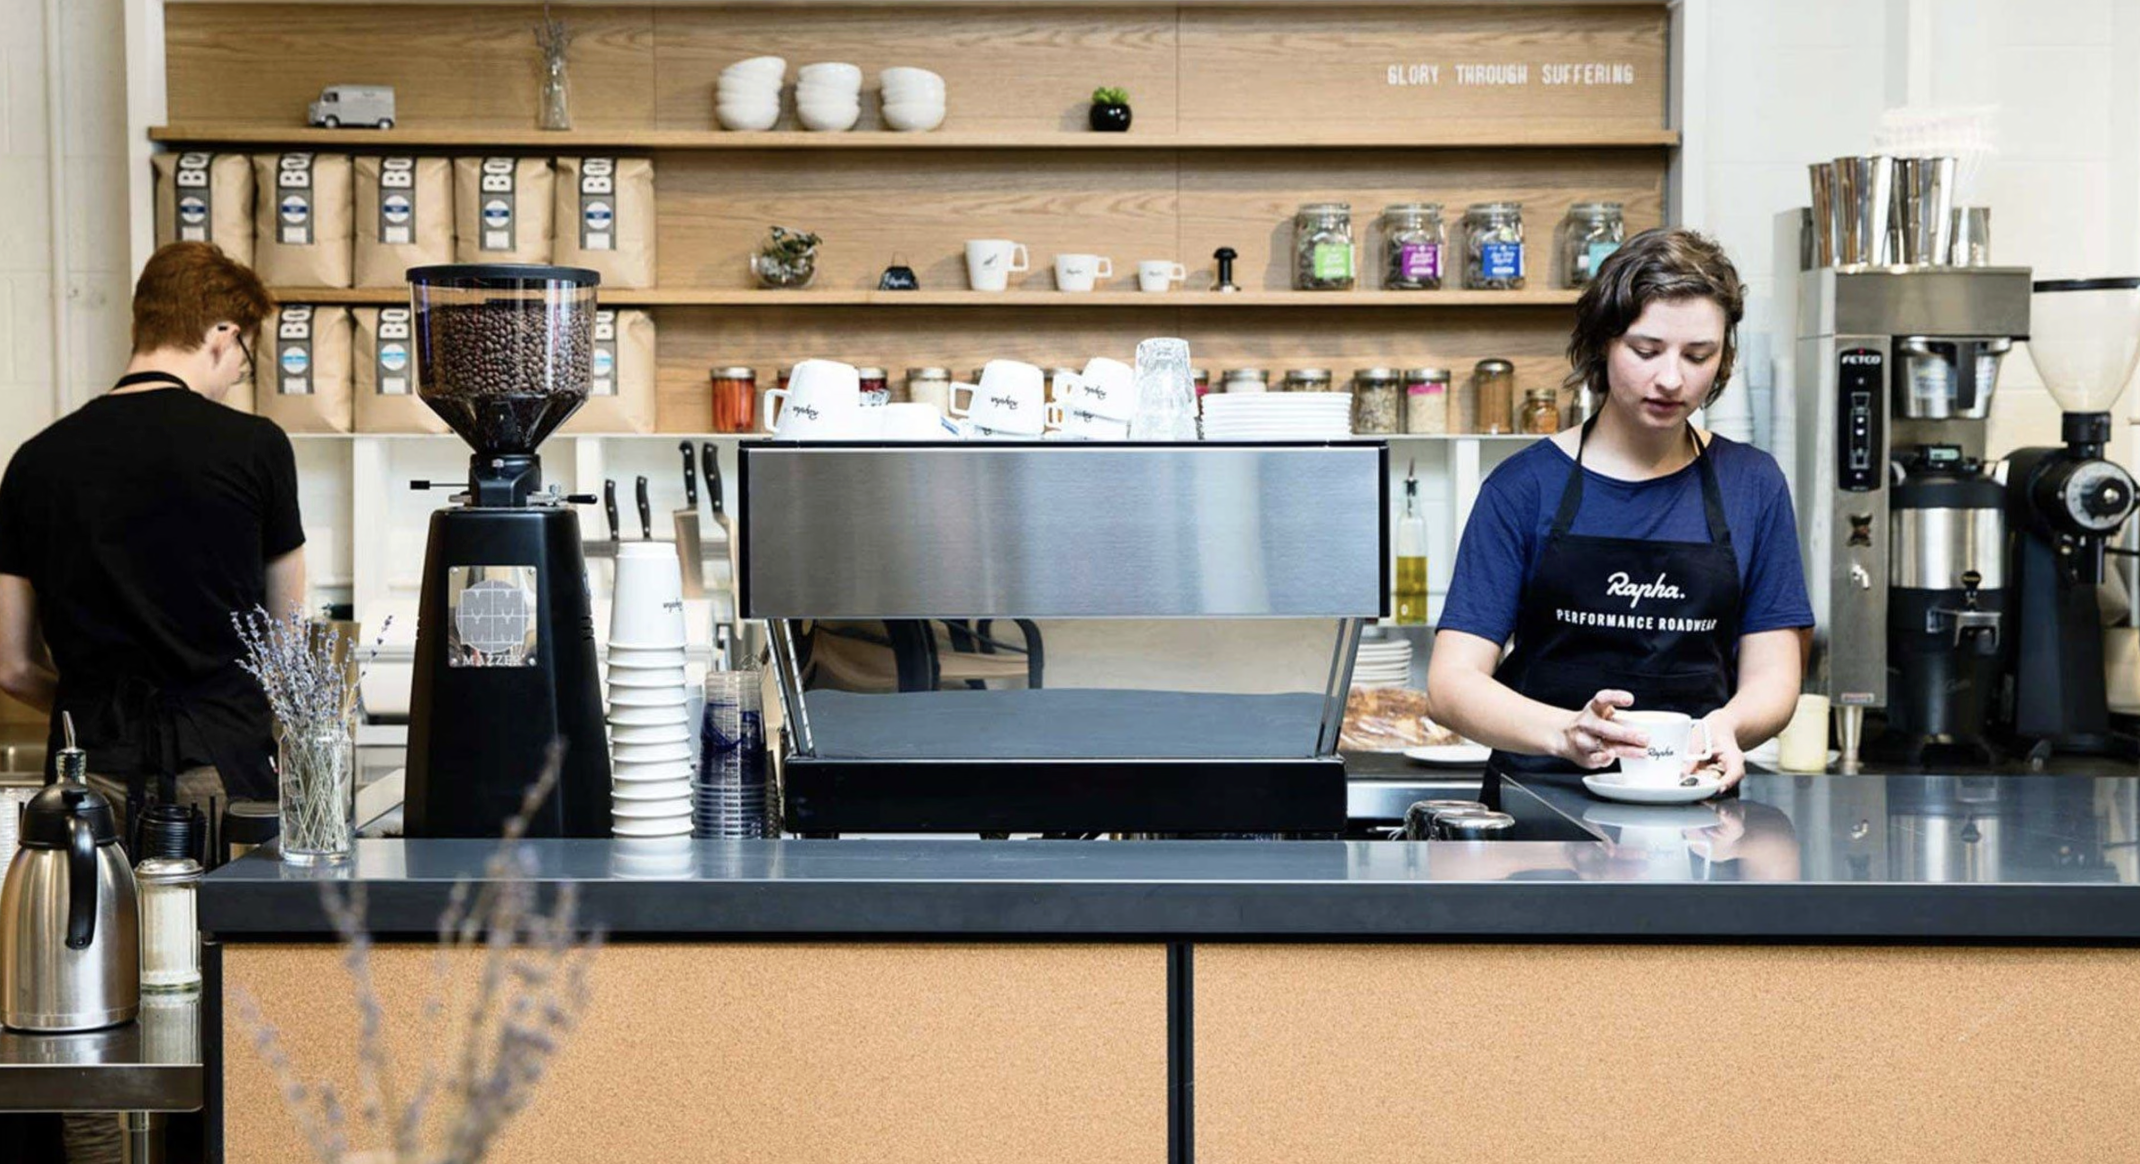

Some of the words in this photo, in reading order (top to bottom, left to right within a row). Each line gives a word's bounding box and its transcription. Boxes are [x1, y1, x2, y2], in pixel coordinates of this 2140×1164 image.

[1387, 64, 1439, 85] GLORY
[1455, 64, 1528, 85] THROUGH
[1542, 64, 1634, 85] SUFFERING
[1606, 571, 1686, 609] Rapha.
[1556, 608, 1654, 630] PERFORMANCE
[1658, 617, 1718, 632] ROADWEAR
[462, 654, 523, 667] MAZZER
